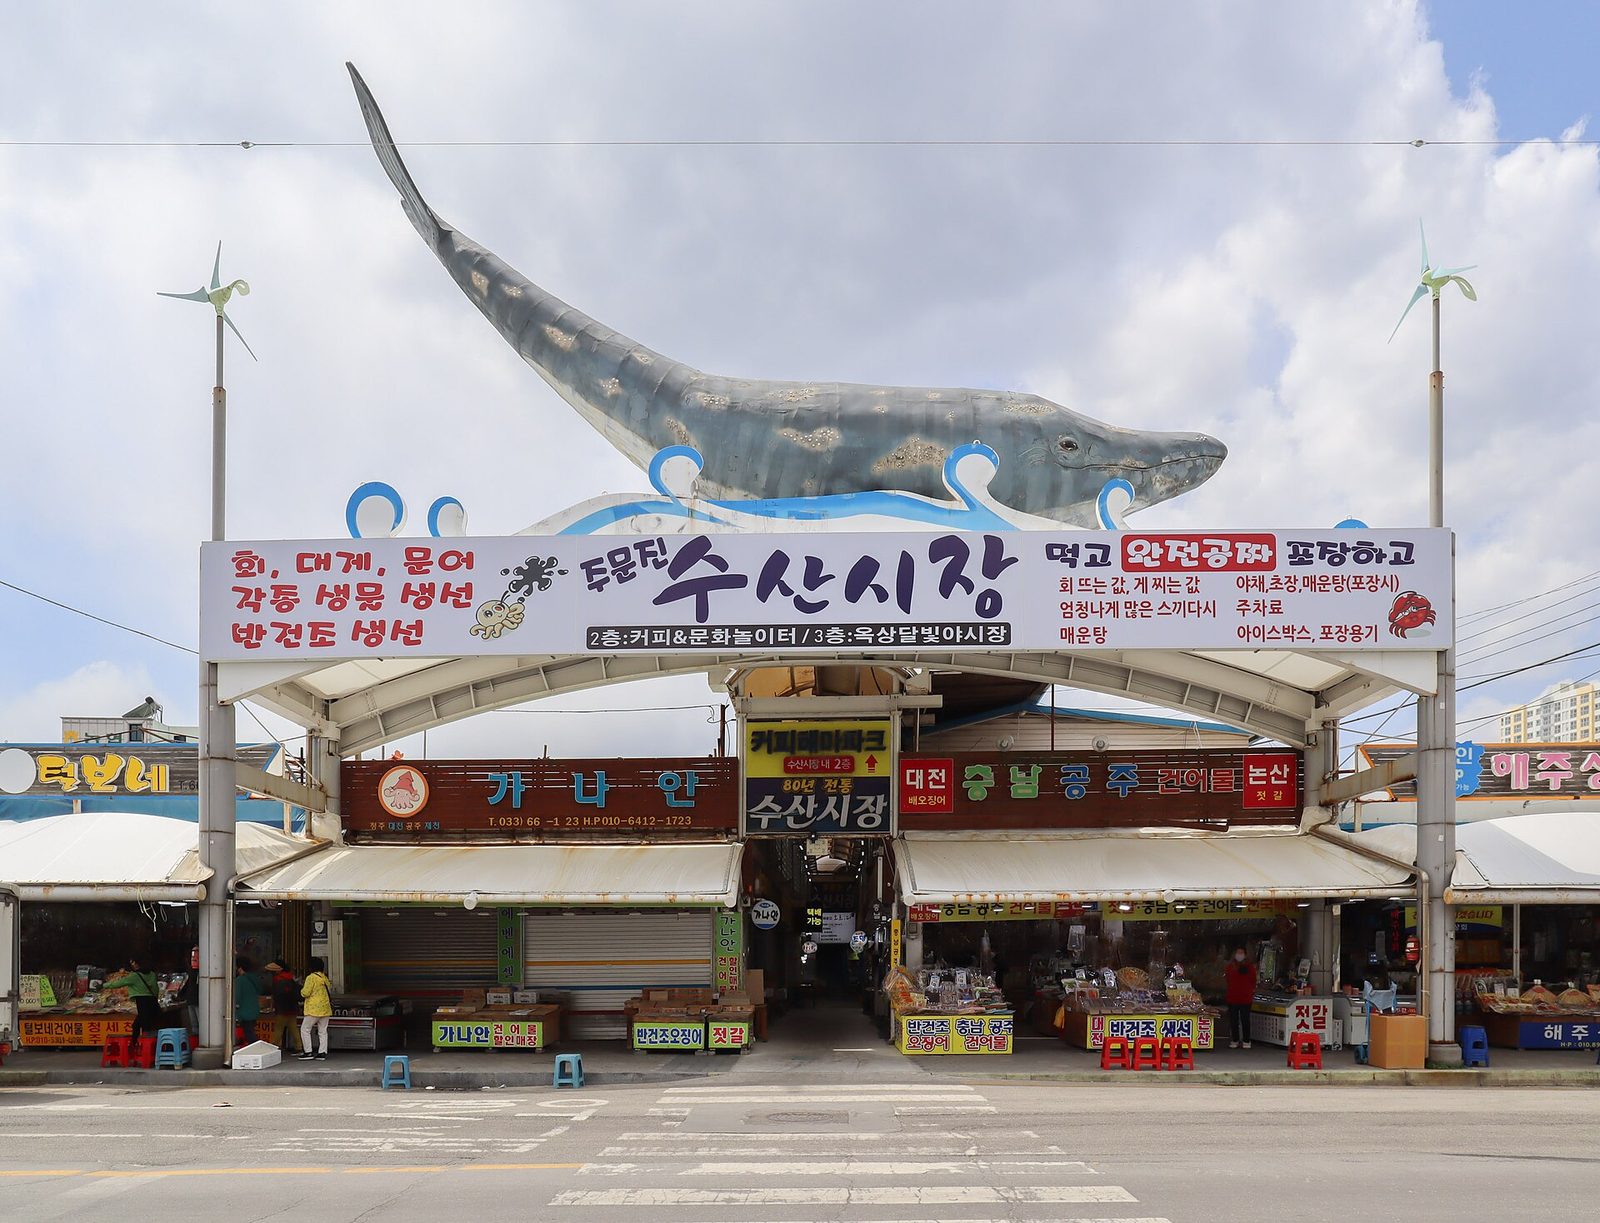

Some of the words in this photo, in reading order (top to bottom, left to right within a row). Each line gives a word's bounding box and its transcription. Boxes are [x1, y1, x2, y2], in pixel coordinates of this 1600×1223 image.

[1045, 542, 1113, 568] 먹고
[1125, 538, 1274, 568] 완전공짜
[1286, 540, 1416, 567] 포장하고
[231, 549, 280, 579] 회,
[296, 551, 387, 577] 대게,
[403, 547, 475, 576] 문어
[579, 536, 669, 592] 주문진
[651, 533, 1019, 625] 수산시장
[1059, 576, 1074, 595] 회
[1077, 576, 1109, 595] 뜨는
[1133, 576, 1149, 595] 게
[1151, 576, 1183, 595] 찌는
[1185, 576, 1202, 595] 값
[231, 584, 301, 614] 각종
[400, 581, 473, 611] 생선
[1060, 602, 1120, 620] 엄청나게
[1123, 600, 1154, 619] 많은
[1157, 600, 1217, 619] 스끼다시
[1236, 599, 1284, 617] 주차료
[231, 621, 336, 650] 반건조
[351, 620, 424, 649] 생선
[590, 626, 796, 648] 2층:커피&문화놀이터
[814, 624, 1007, 646] 3층:옥상달빛야시장
[1060, 626, 1107, 645] 매운탕
[1237, 624, 1316, 643] 아이스박스,
[1319, 624, 1379, 643] 포장용기
[751, 729, 887, 755] 커피테마파크
[787, 758, 820, 770] 수산시장
[821, 758, 830, 770] 내
[834, 757, 851, 770] 2층
[905, 767, 946, 790] 대전
[961, 764, 1042, 802] 충남
[1060, 763, 1140, 800] 공주
[1158, 767, 1235, 795] 건어물
[1248, 763, 1290, 786] 논산
[783, 779, 815, 793] 80년
[823, 778, 853, 794] 전통
[908, 795, 946, 807] 배오징어
[747, 794, 888, 829] 수산시장
[754, 910, 779, 922] 가나안
[806, 917, 823, 926] 가능
[720, 915, 736, 952] 가나안
[906, 1019, 951, 1035] 반건조
[956, 1018, 986, 1036] 충남
[988, 1019, 1014, 1036] 공주
[1295, 1005, 1328, 1030] 젓갈
[24, 1022, 83, 1035] 털보네건어물
[438, 1026, 490, 1044] 가나안
[637, 1028, 702, 1045] 반건조오징어
[712, 1027, 745, 1045] 젓갈
[1091, 1016, 1105, 1046] 대전
[1108, 1019, 1158, 1039] 반건조
[1197, 1016, 1212, 1046] 논산
[493, 1035, 538, 1047] 할인매장
[906, 1035, 950, 1052] 오징어
[965, 1035, 1009, 1051] 건어물
